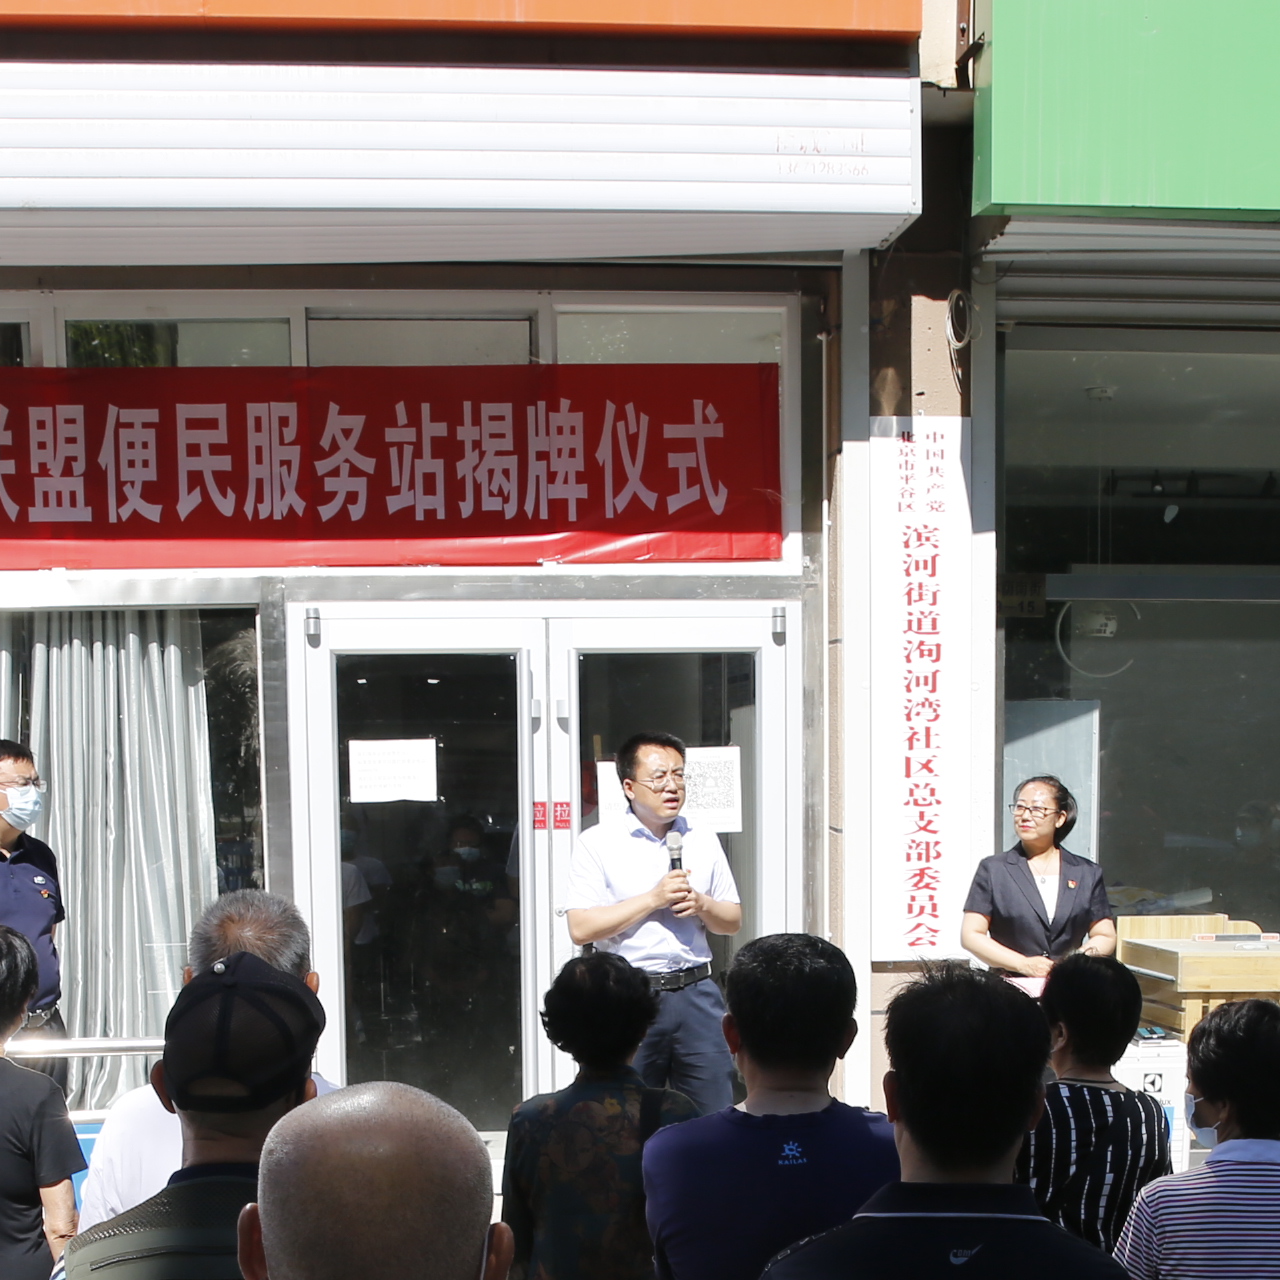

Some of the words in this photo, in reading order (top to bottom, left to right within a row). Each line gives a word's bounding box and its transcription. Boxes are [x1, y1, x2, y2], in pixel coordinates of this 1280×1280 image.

[897, 431, 917, 513] 北京市平谷区
[926, 431, 946, 513] 中国共产党
[902, 524, 943, 947] 滨河街道泃河湾社区总支部委员会
[554, 803, 570, 821] 拉
